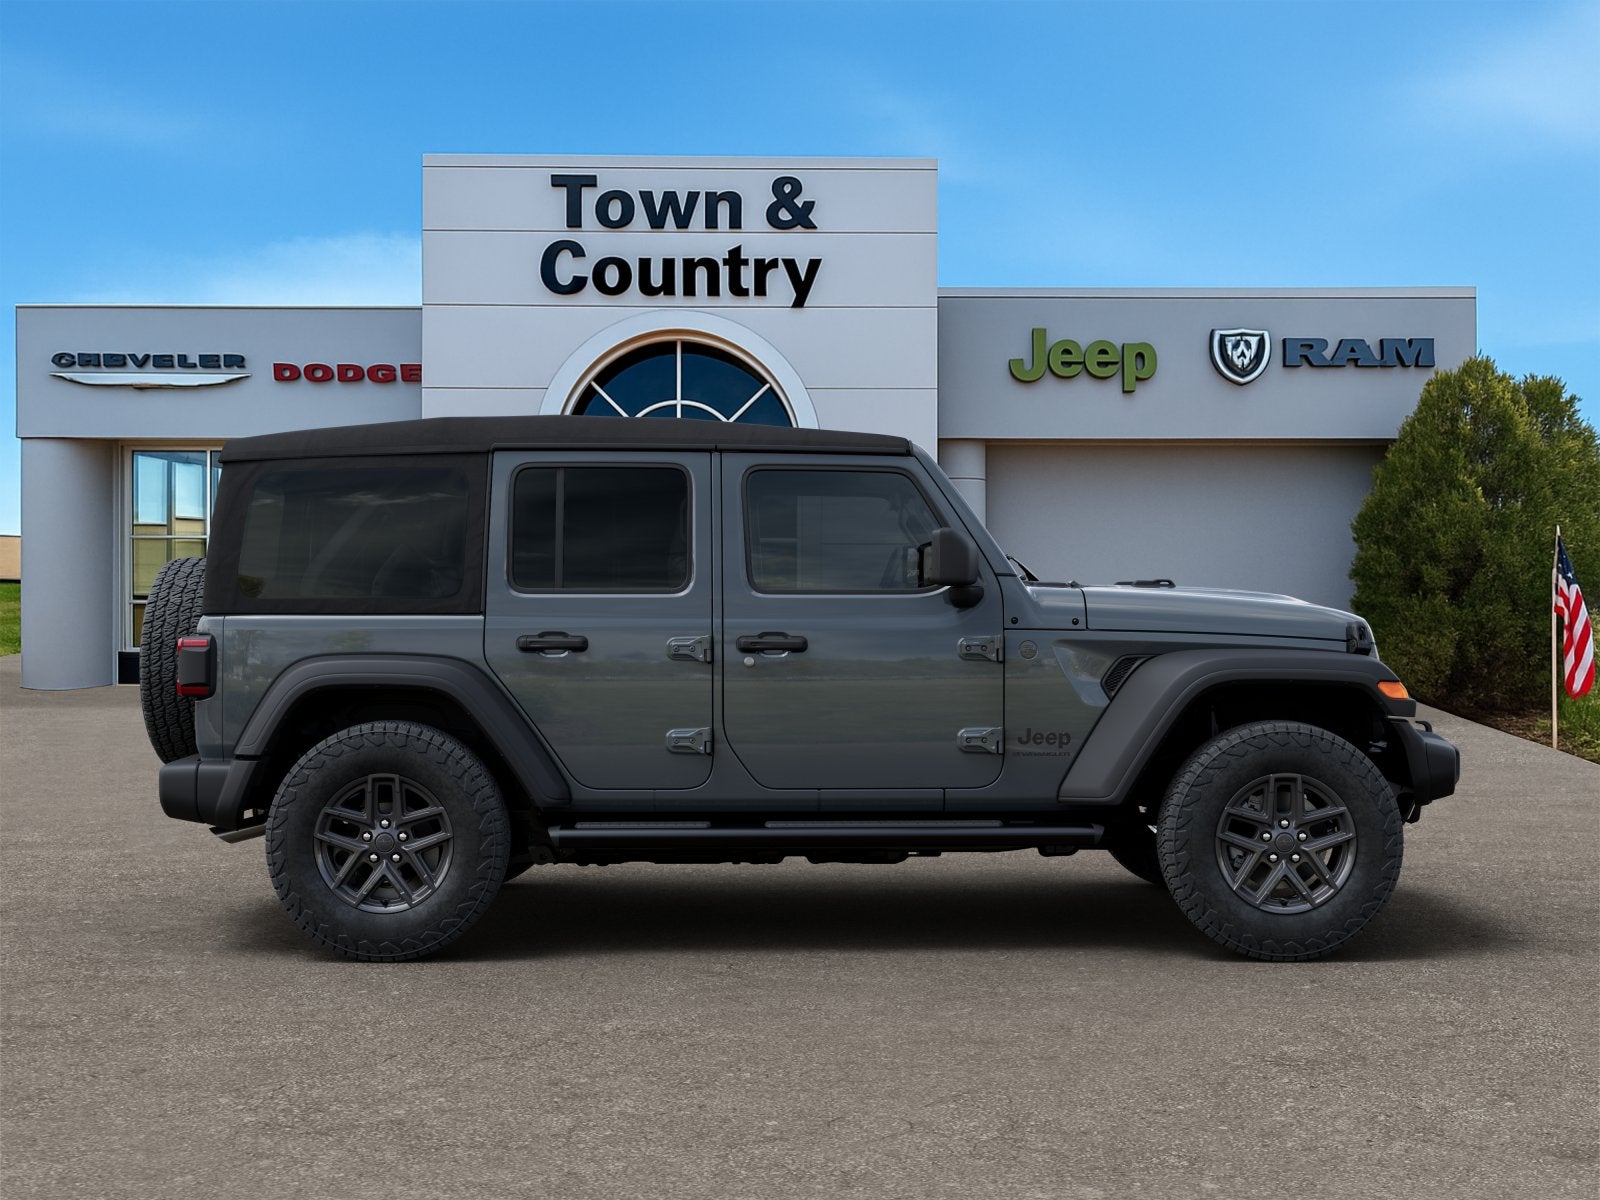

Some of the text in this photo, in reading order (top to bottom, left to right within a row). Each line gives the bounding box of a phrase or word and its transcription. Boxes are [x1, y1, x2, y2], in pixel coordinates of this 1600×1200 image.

[550, 174, 818, 229] Town &
[540, 239, 822, 308] Country
[273, 363, 422, 383] DODGE
[1008, 327, 1158, 393] Jeep
[1282, 337, 1436, 368] RAM
[1018, 728, 1071, 748] Jeep
